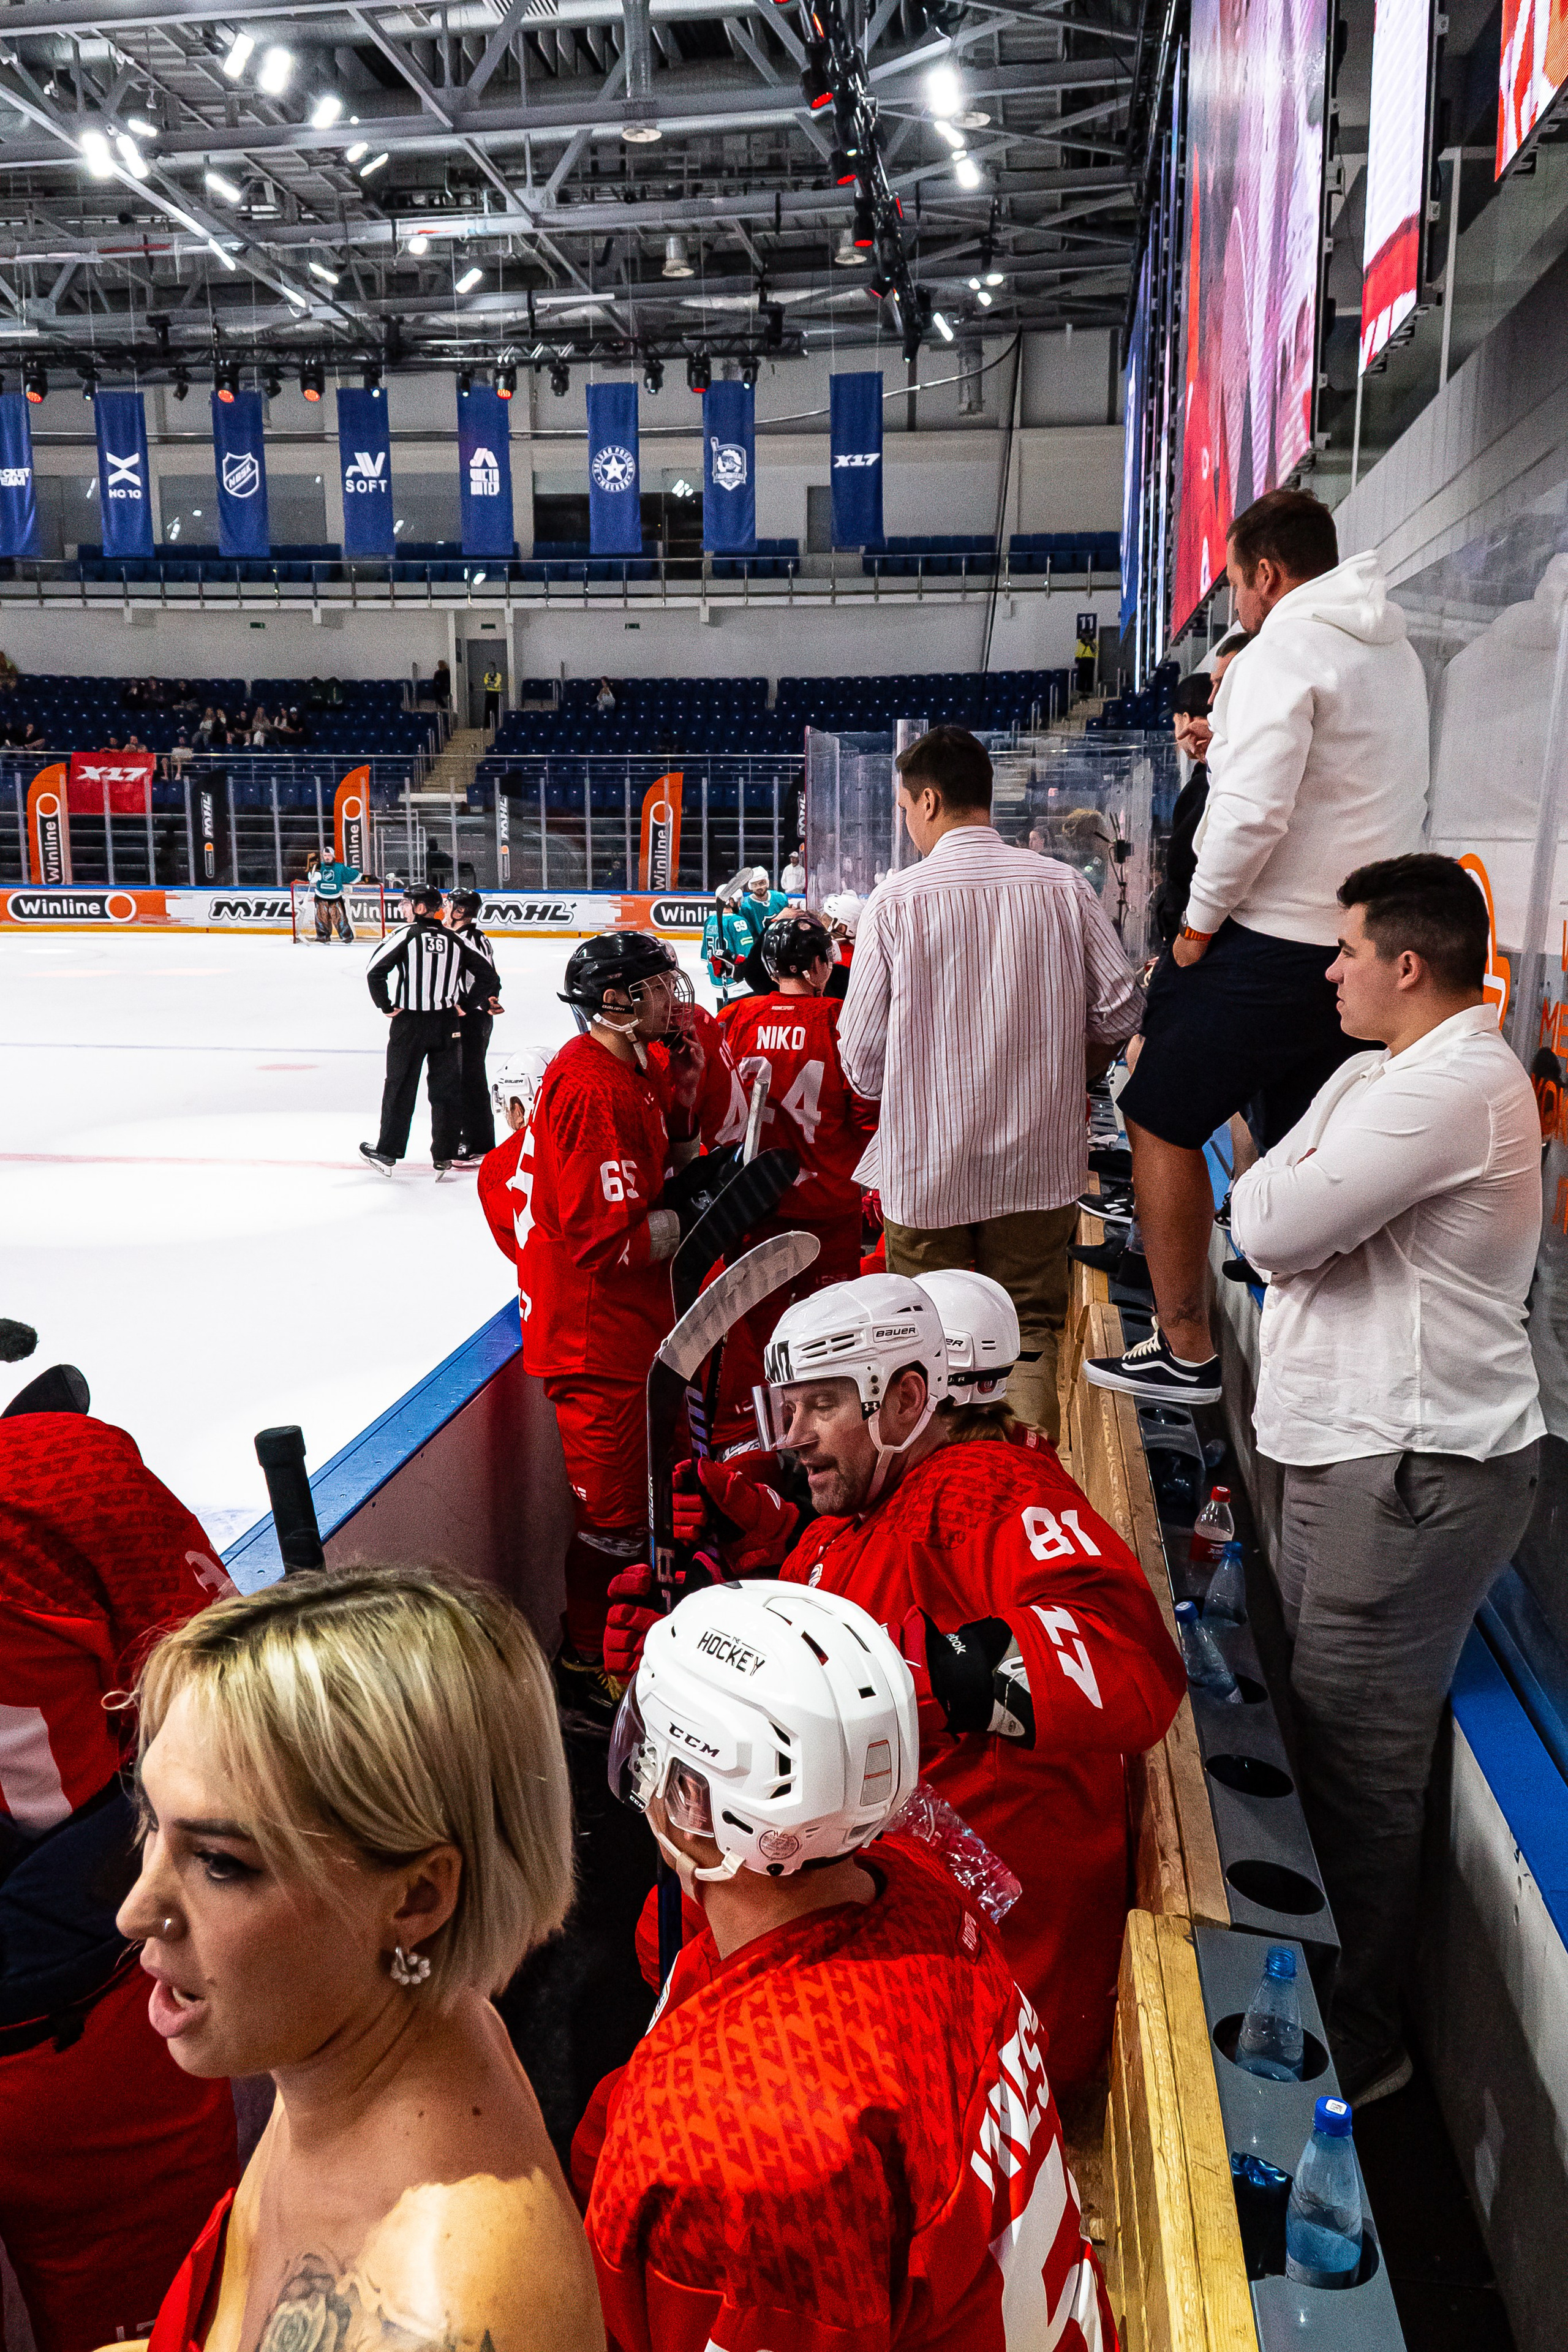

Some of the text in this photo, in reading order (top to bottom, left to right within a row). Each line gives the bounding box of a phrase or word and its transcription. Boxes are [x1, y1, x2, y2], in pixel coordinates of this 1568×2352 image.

[834, 453, 880, 467] X17
[345, 480, 387, 493] SOFT
[1080, 616, 1093, 630] 11
[77, 765, 148, 782] X17
[202, 794, 213, 837] MHL
[45, 821, 59, 882] Winline
[349, 824, 360, 869] inline
[653, 829, 668, 891] Winline
[19, 899, 100, 915] Winline
[211, 900, 296, 918] MHL
[482, 904, 571, 920] MHL
[733, 919, 748, 932] 59
[428, 938, 443, 952] 36
[756, 1025, 805, 1050] NIKO
[600, 1160, 639, 1202] 65
[875, 1327, 916, 1339] BAUER
[1021, 1506, 1102, 1561] 81
[696, 1631, 766, 1676] HOCKEY
[669, 1721, 720, 1759] CCM
[629, 1795, 644, 1809] CCM
